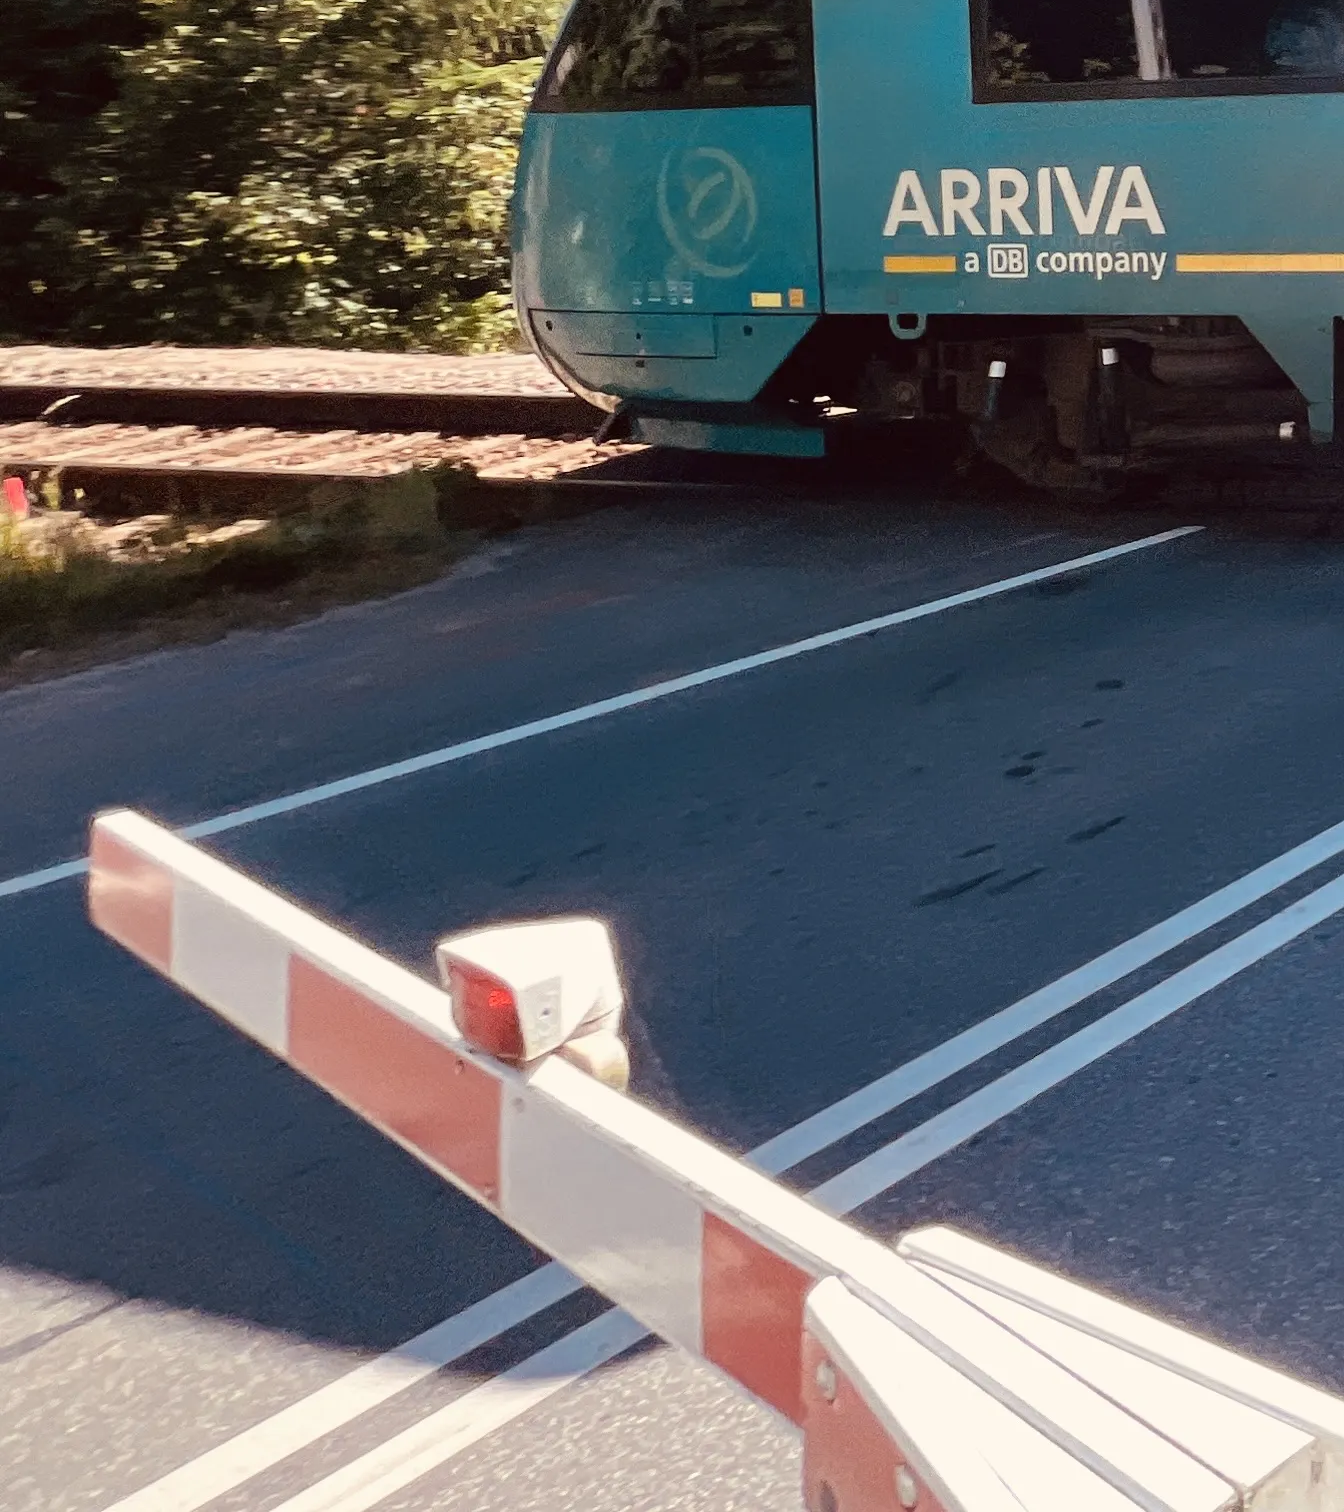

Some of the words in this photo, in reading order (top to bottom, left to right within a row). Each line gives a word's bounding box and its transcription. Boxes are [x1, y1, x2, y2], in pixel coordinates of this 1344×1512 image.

[883, 165, 1166, 236] ARRIVA
[964, 251, 980, 273] a
[991, 247, 1025, 274] DB
[1036, 249, 1167, 280] company
